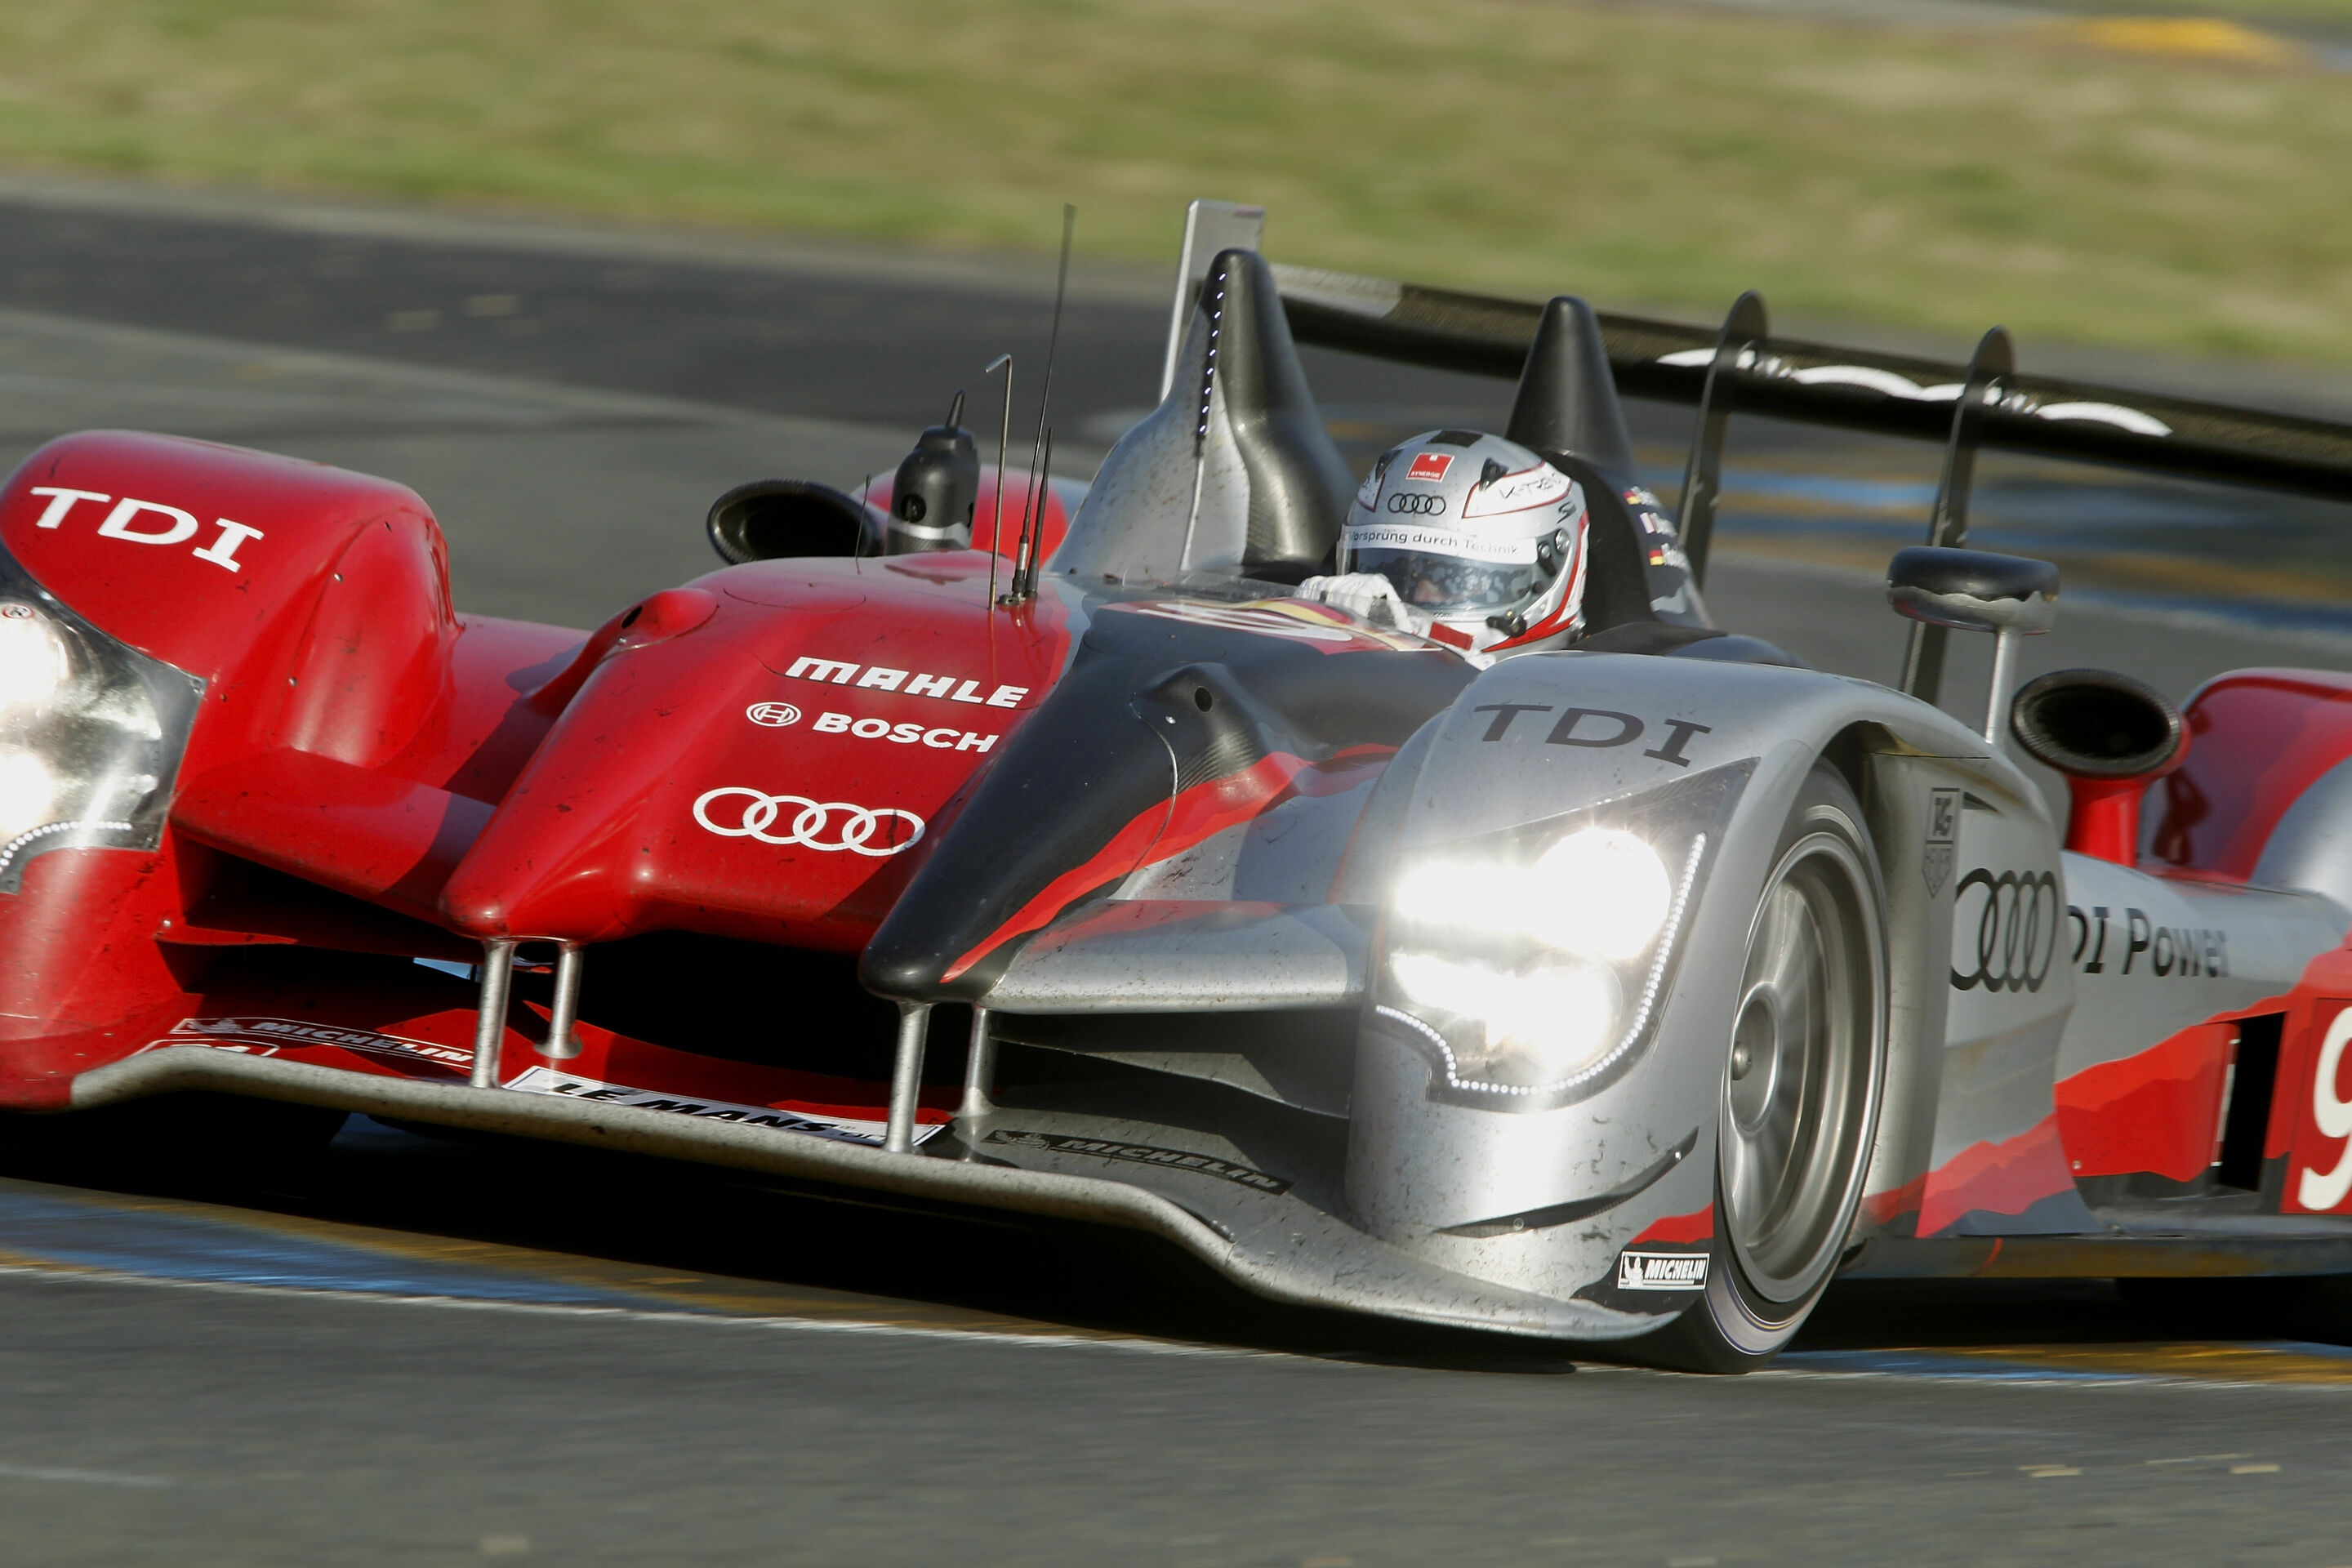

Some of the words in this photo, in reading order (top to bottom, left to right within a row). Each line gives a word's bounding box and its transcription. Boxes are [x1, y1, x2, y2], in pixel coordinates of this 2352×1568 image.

[31, 487, 265, 572] TDI
[1413, 532, 1459, 547] durch
[785, 657, 1029, 709] MAHLE
[812, 712, 1000, 753] BOSCH
[1473, 704, 1713, 768] TDI
[250, 1022, 474, 1062] MICHELIN
[553, 1083, 629, 1101] LE
[630, 1099, 840, 1133] MANS
[1059, 1139, 1281, 1189] MICHELIN
[1644, 1259, 1707, 1280] MICHELIN
